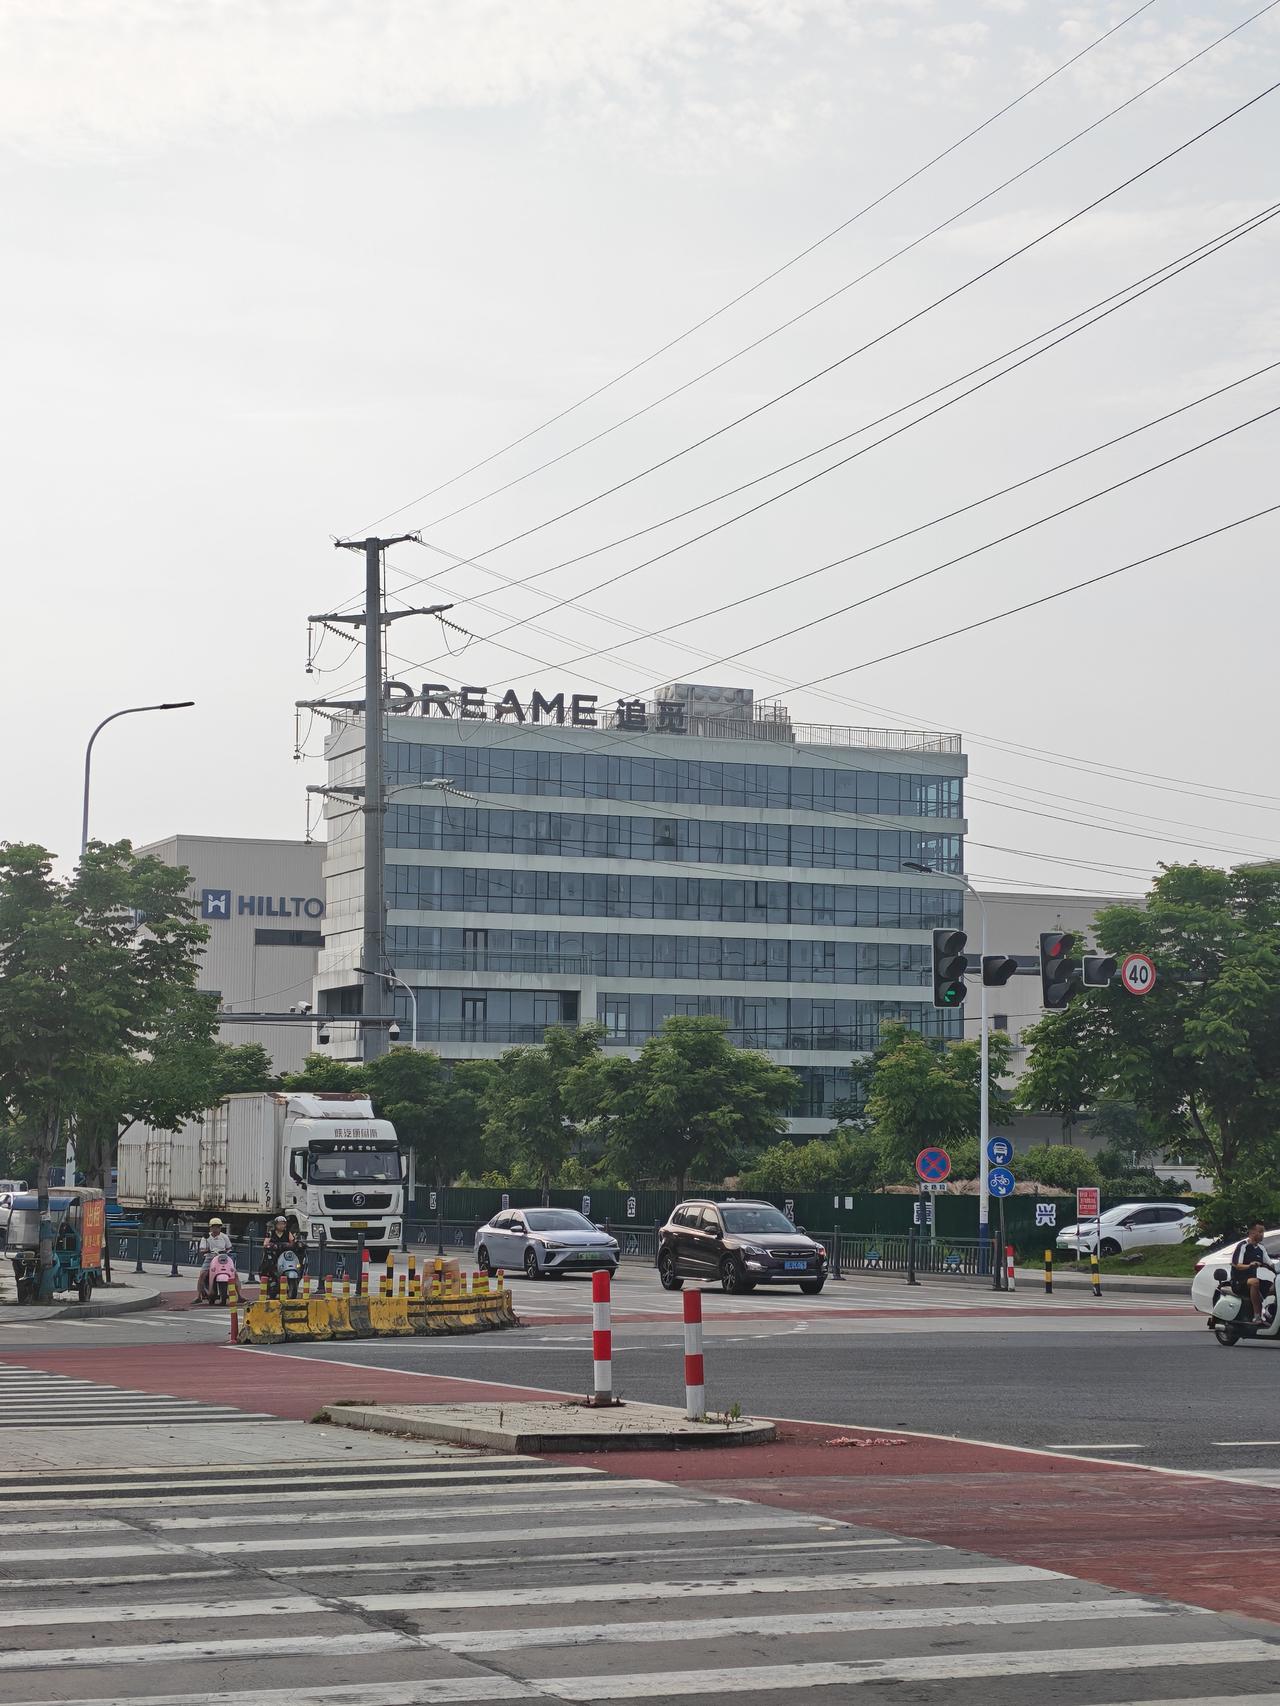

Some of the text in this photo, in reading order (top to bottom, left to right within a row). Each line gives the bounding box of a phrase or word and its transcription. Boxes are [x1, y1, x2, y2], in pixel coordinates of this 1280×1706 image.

[383, 681, 688, 734] DREAME 追觅
[238, 895, 325, 919] HILLTO
[1128, 965, 1149, 984] 40
[1037, 1204, 1056, 1226] 兴
